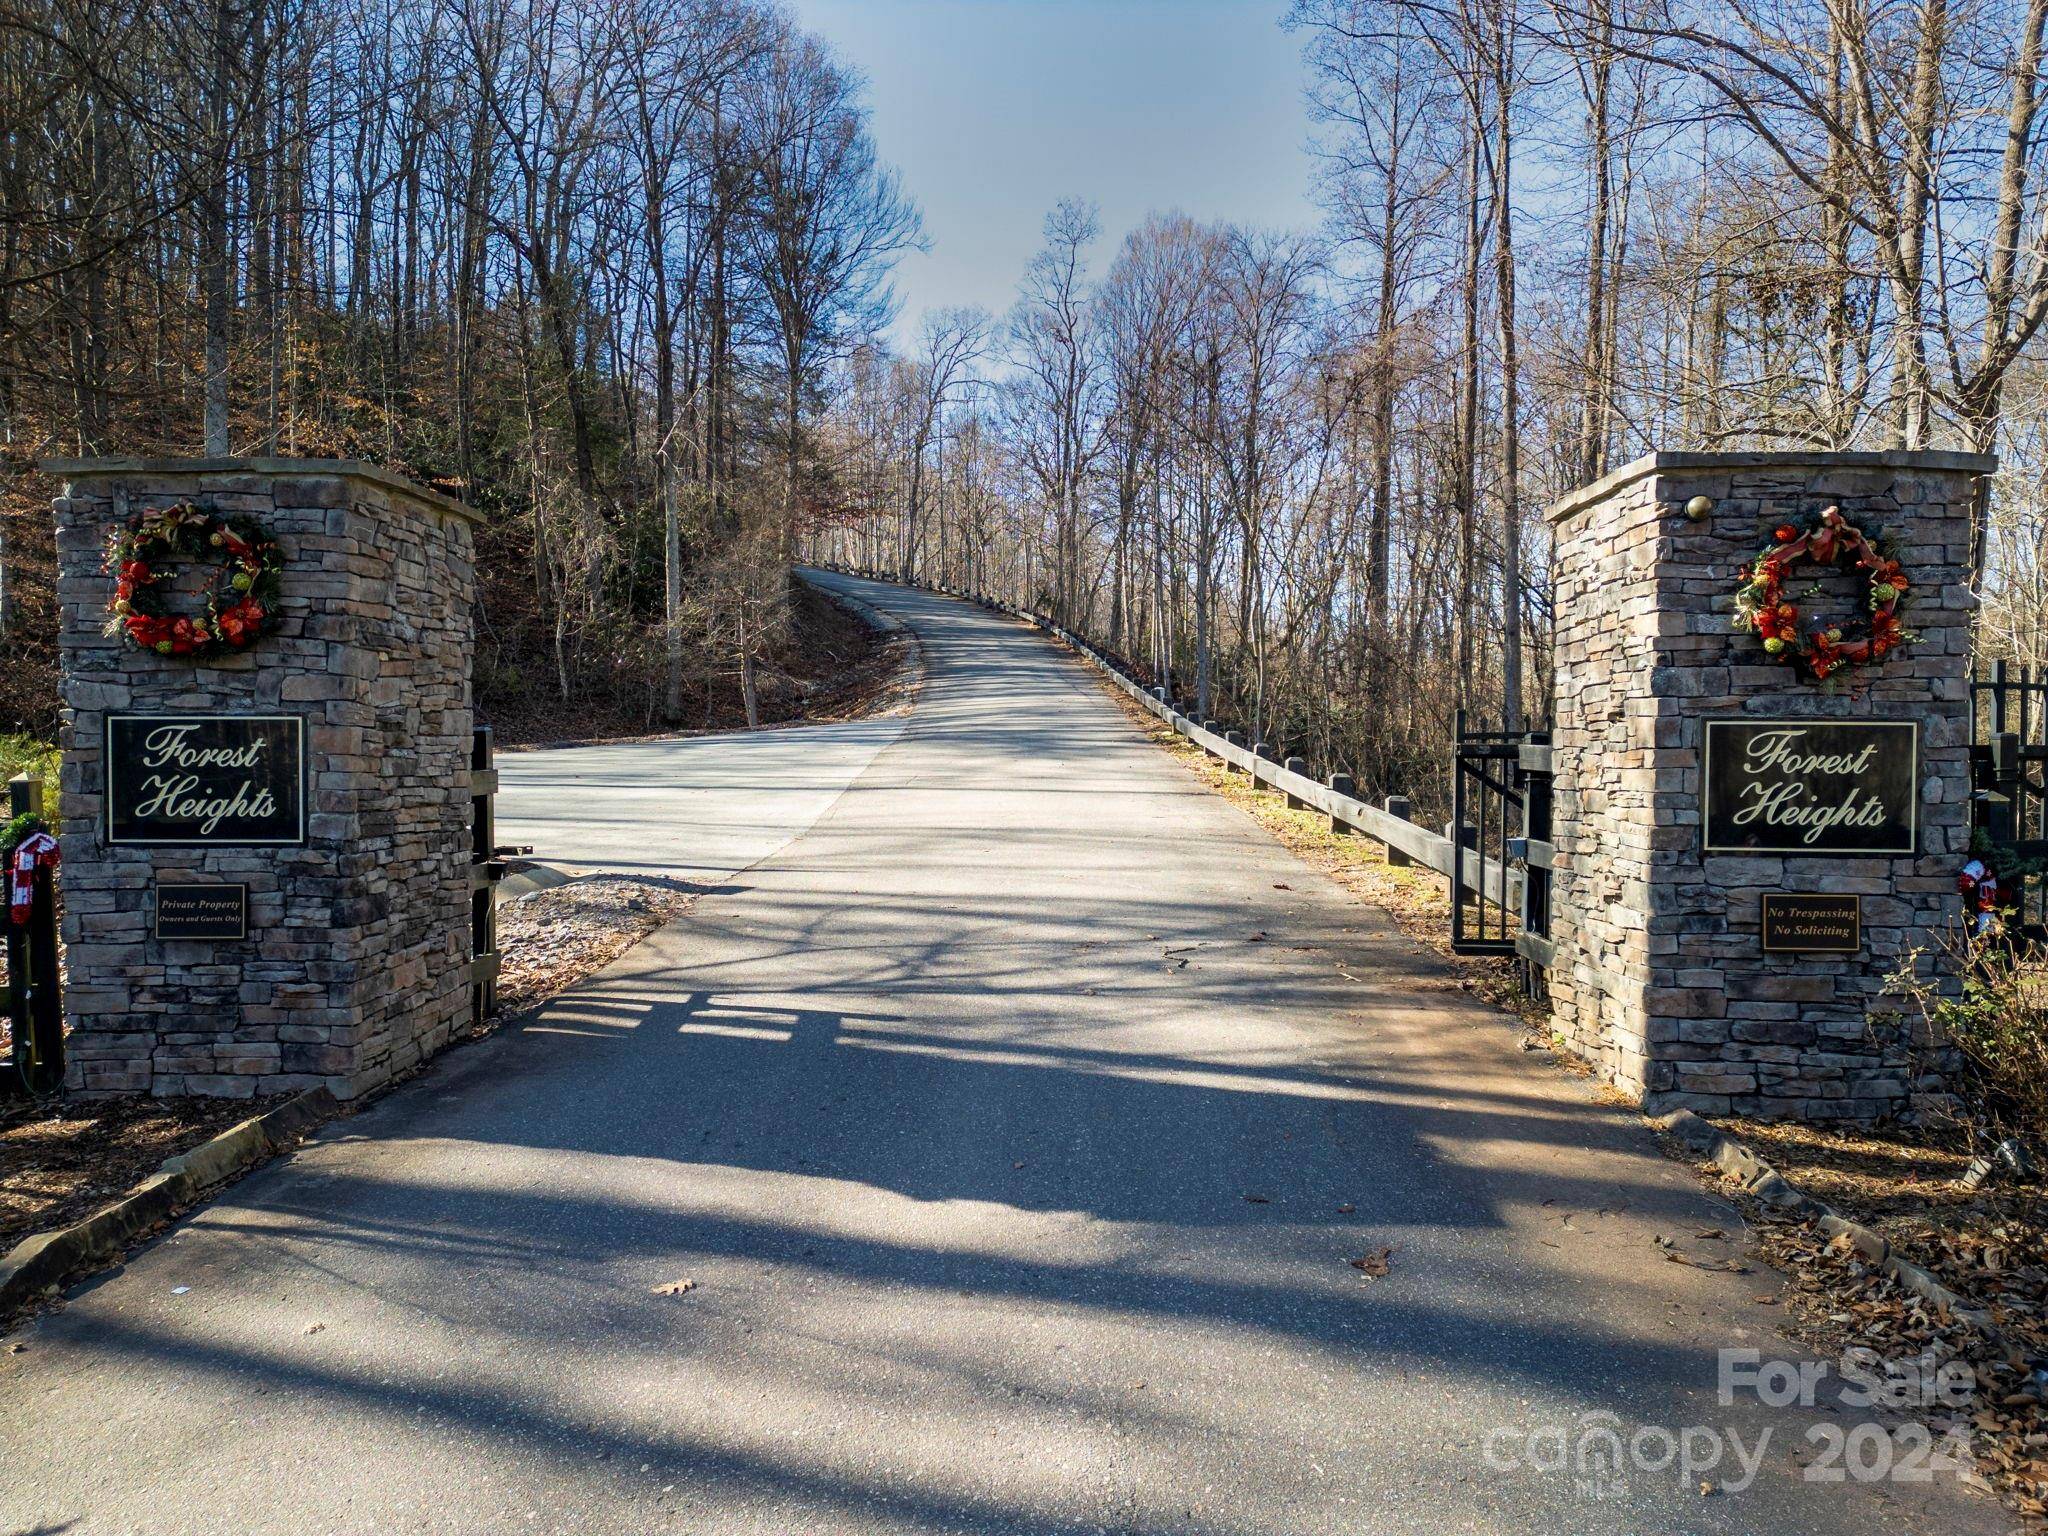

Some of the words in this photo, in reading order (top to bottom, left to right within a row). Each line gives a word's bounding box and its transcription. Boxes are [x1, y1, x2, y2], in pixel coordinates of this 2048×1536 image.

[142, 724, 267, 767] Forest
[1743, 729, 1878, 775] Forest
[134, 774, 276, 835] Heights
[1732, 781, 1887, 844] Heights
[161, 899, 196, 909] Private
[198, 899, 240, 911] Property
[225, 914, 241, 923] Only
[1768, 907, 1784, 918] No
[1789, 907, 1856, 921] Trespassing
[1774, 925, 1791, 935] No
[1794, 925, 1850, 938] Soliciting
